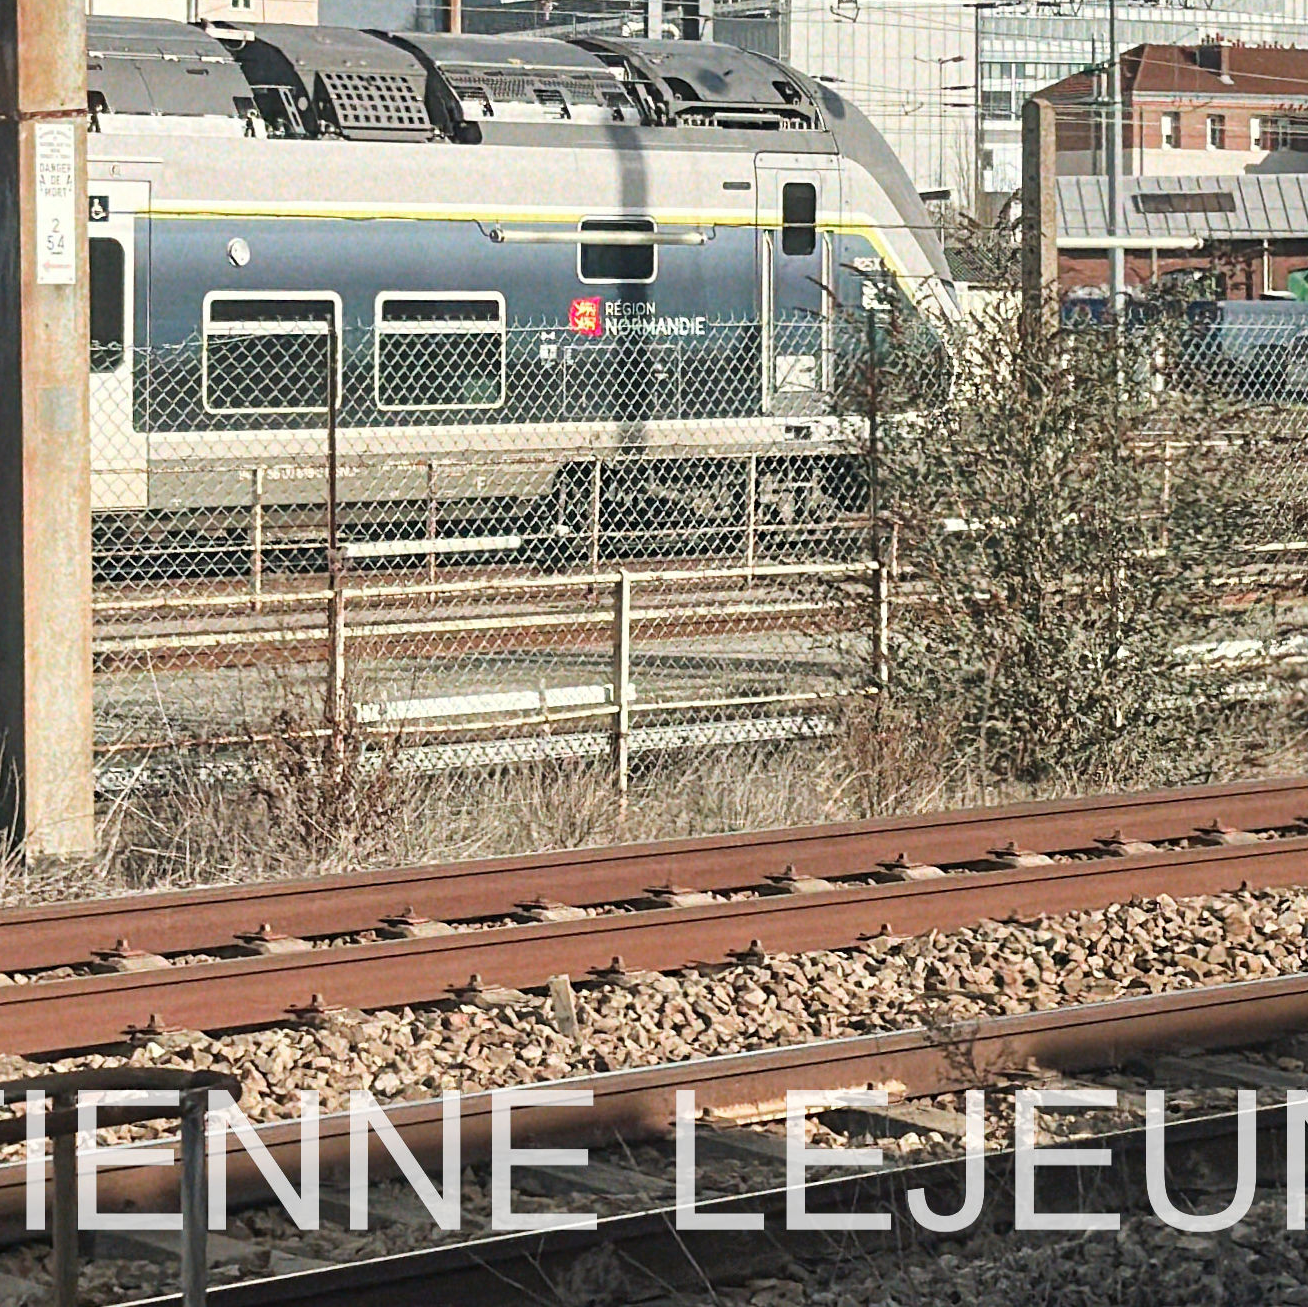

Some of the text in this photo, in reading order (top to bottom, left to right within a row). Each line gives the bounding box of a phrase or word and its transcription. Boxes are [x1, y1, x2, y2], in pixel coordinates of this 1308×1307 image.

[39, 163, 71, 173] DANGER
[51, 218, 60, 233] 2
[46, 235, 64, 251] 54
[605, 299, 656, 316] RÉGION
[605, 316, 706, 336] NORMANDIE
